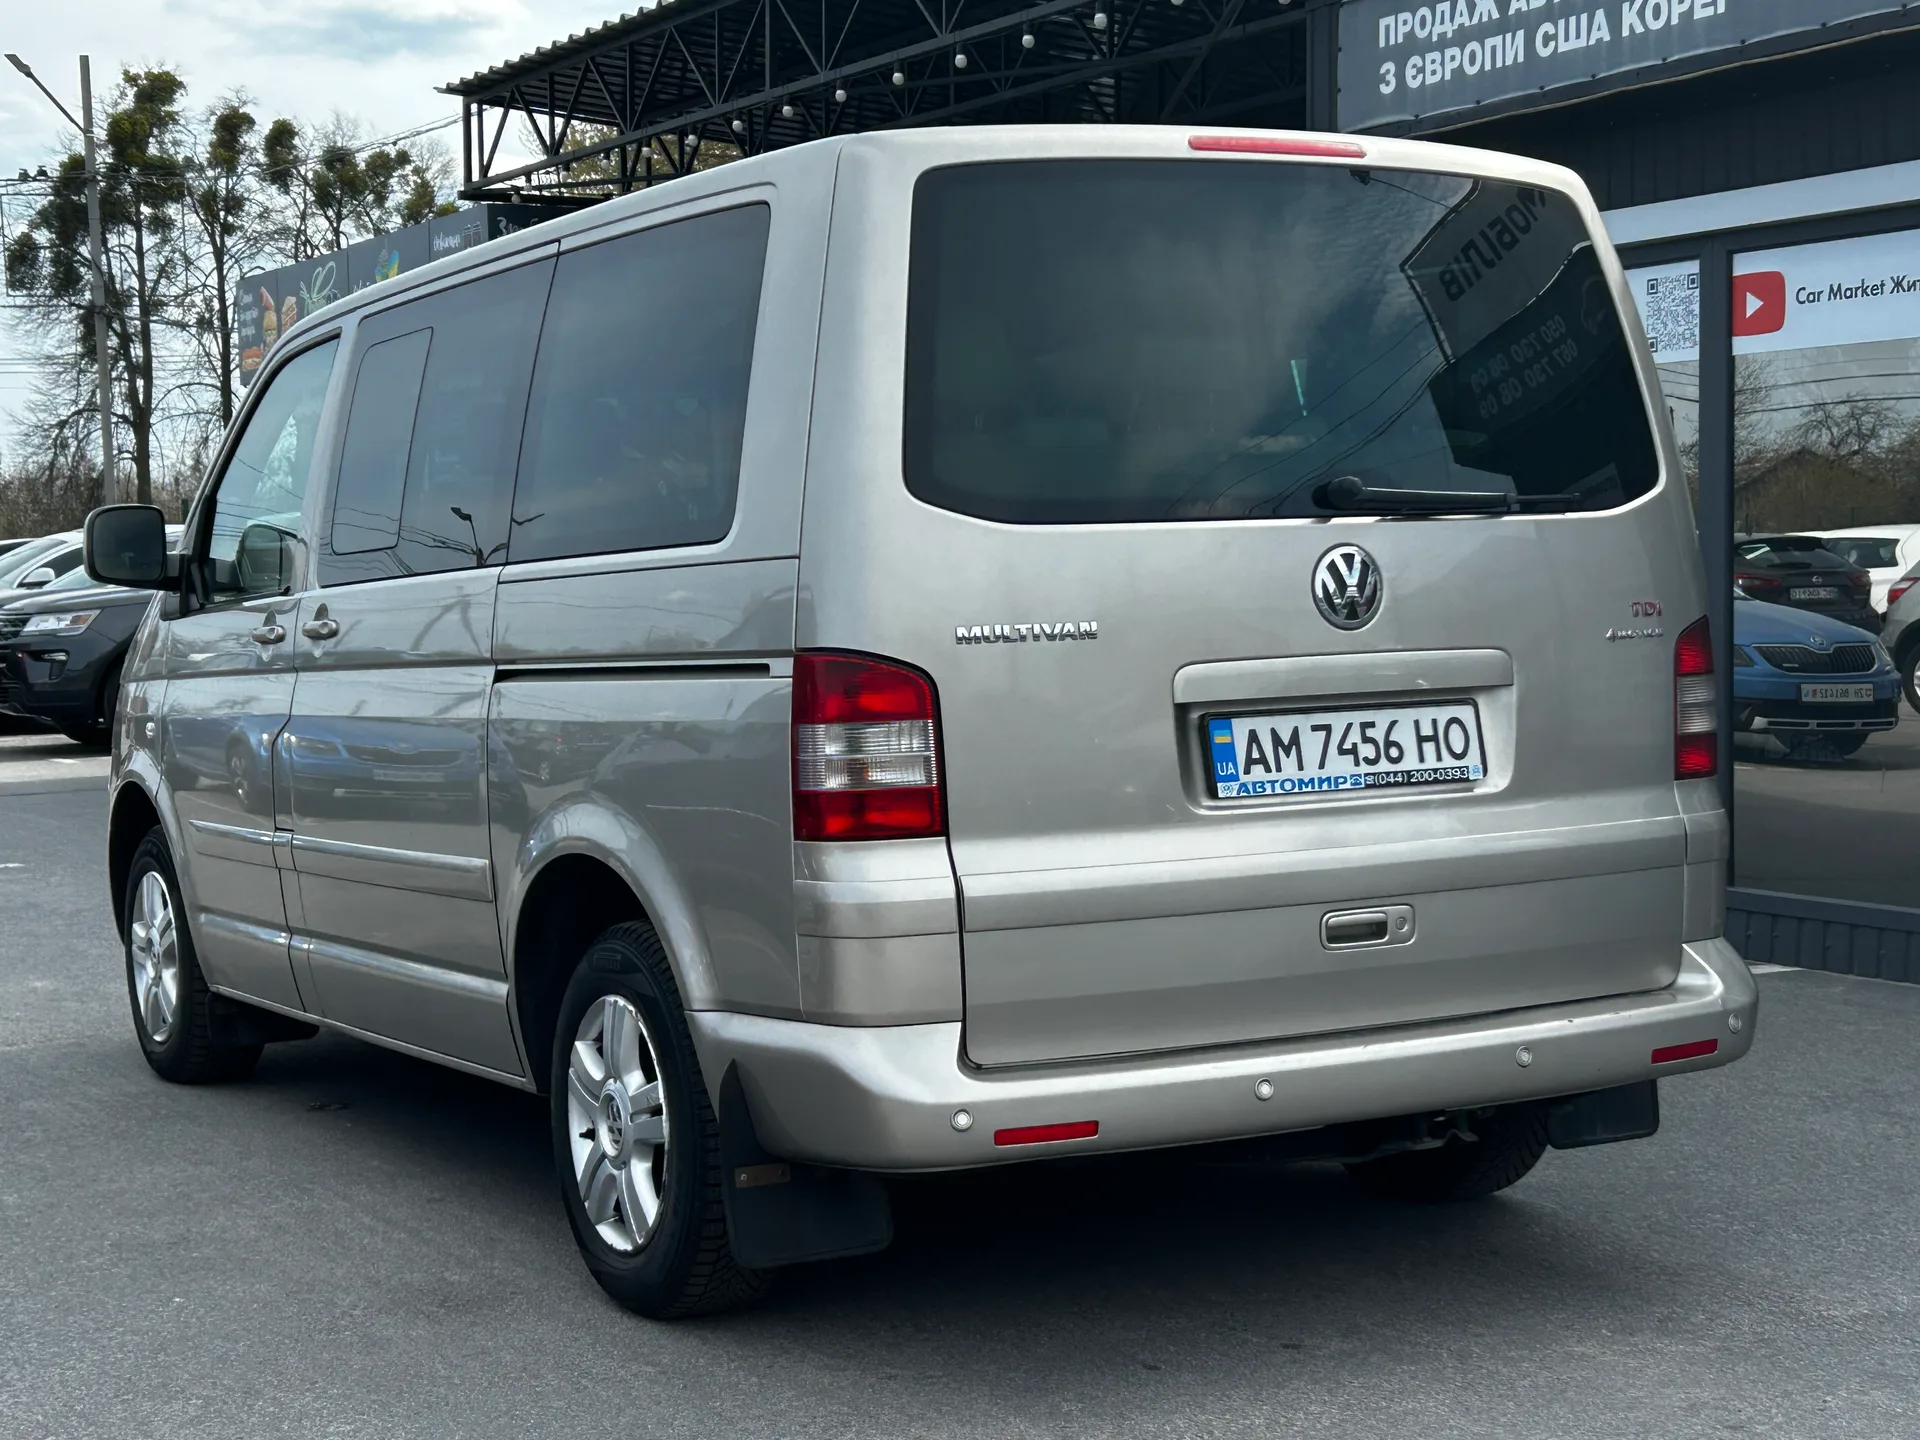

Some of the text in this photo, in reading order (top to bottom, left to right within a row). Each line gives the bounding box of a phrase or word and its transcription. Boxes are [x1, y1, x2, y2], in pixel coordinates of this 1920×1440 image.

[1378, 0, 1501, 48] ПРОДАЖ
[1379, 61, 1397, 95] З
[1405, 29, 1525, 90] ЄВРОПИ
[1535, 8, 1611, 58] США
[1795, 286, 1825, 305] Car
[1827, 277, 1887, 302] Market
[955, 620, 1099, 645] MULTIVAN
[1242, 716, 1471, 776] AM 7456 HO
[1217, 761, 1237, 776] UA
[1236, 767, 1469, 796] АВТОМИР (044) 200-0393
